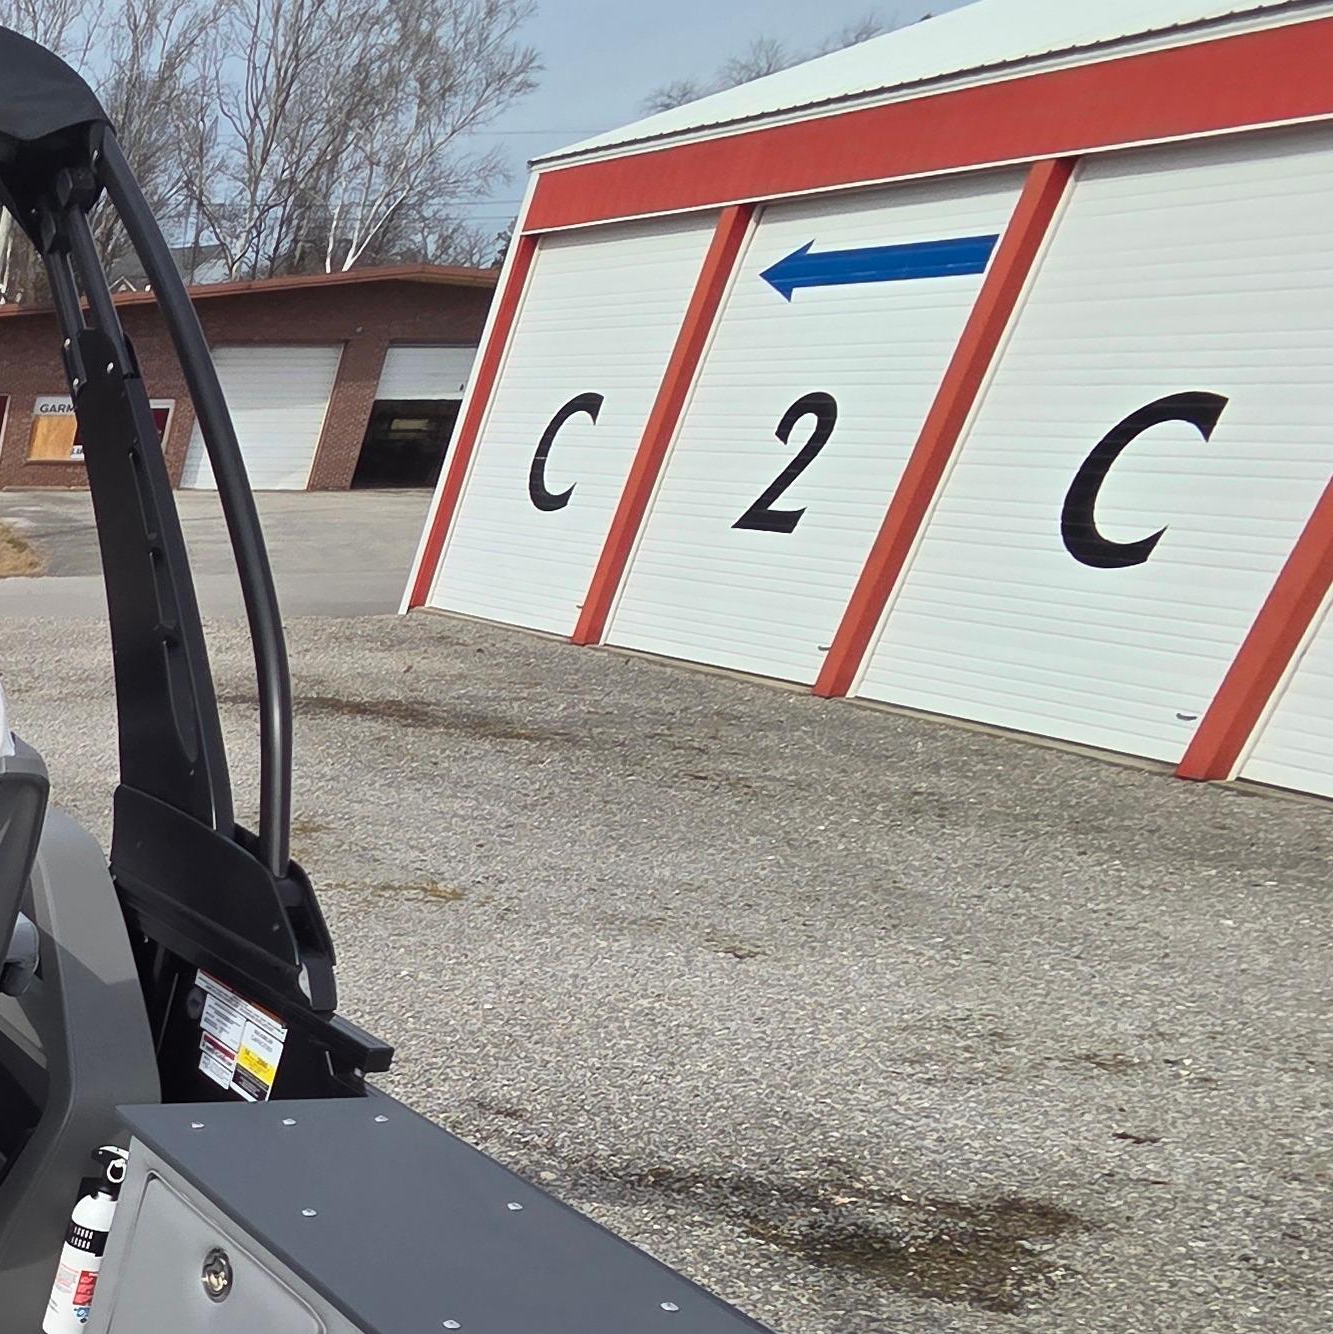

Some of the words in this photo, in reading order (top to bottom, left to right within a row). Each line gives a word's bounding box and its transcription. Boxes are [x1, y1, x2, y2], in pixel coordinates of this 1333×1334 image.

[528, 391, 605, 512] C
[730, 391, 838, 534] 2
[1060, 390, 1230, 569] C
